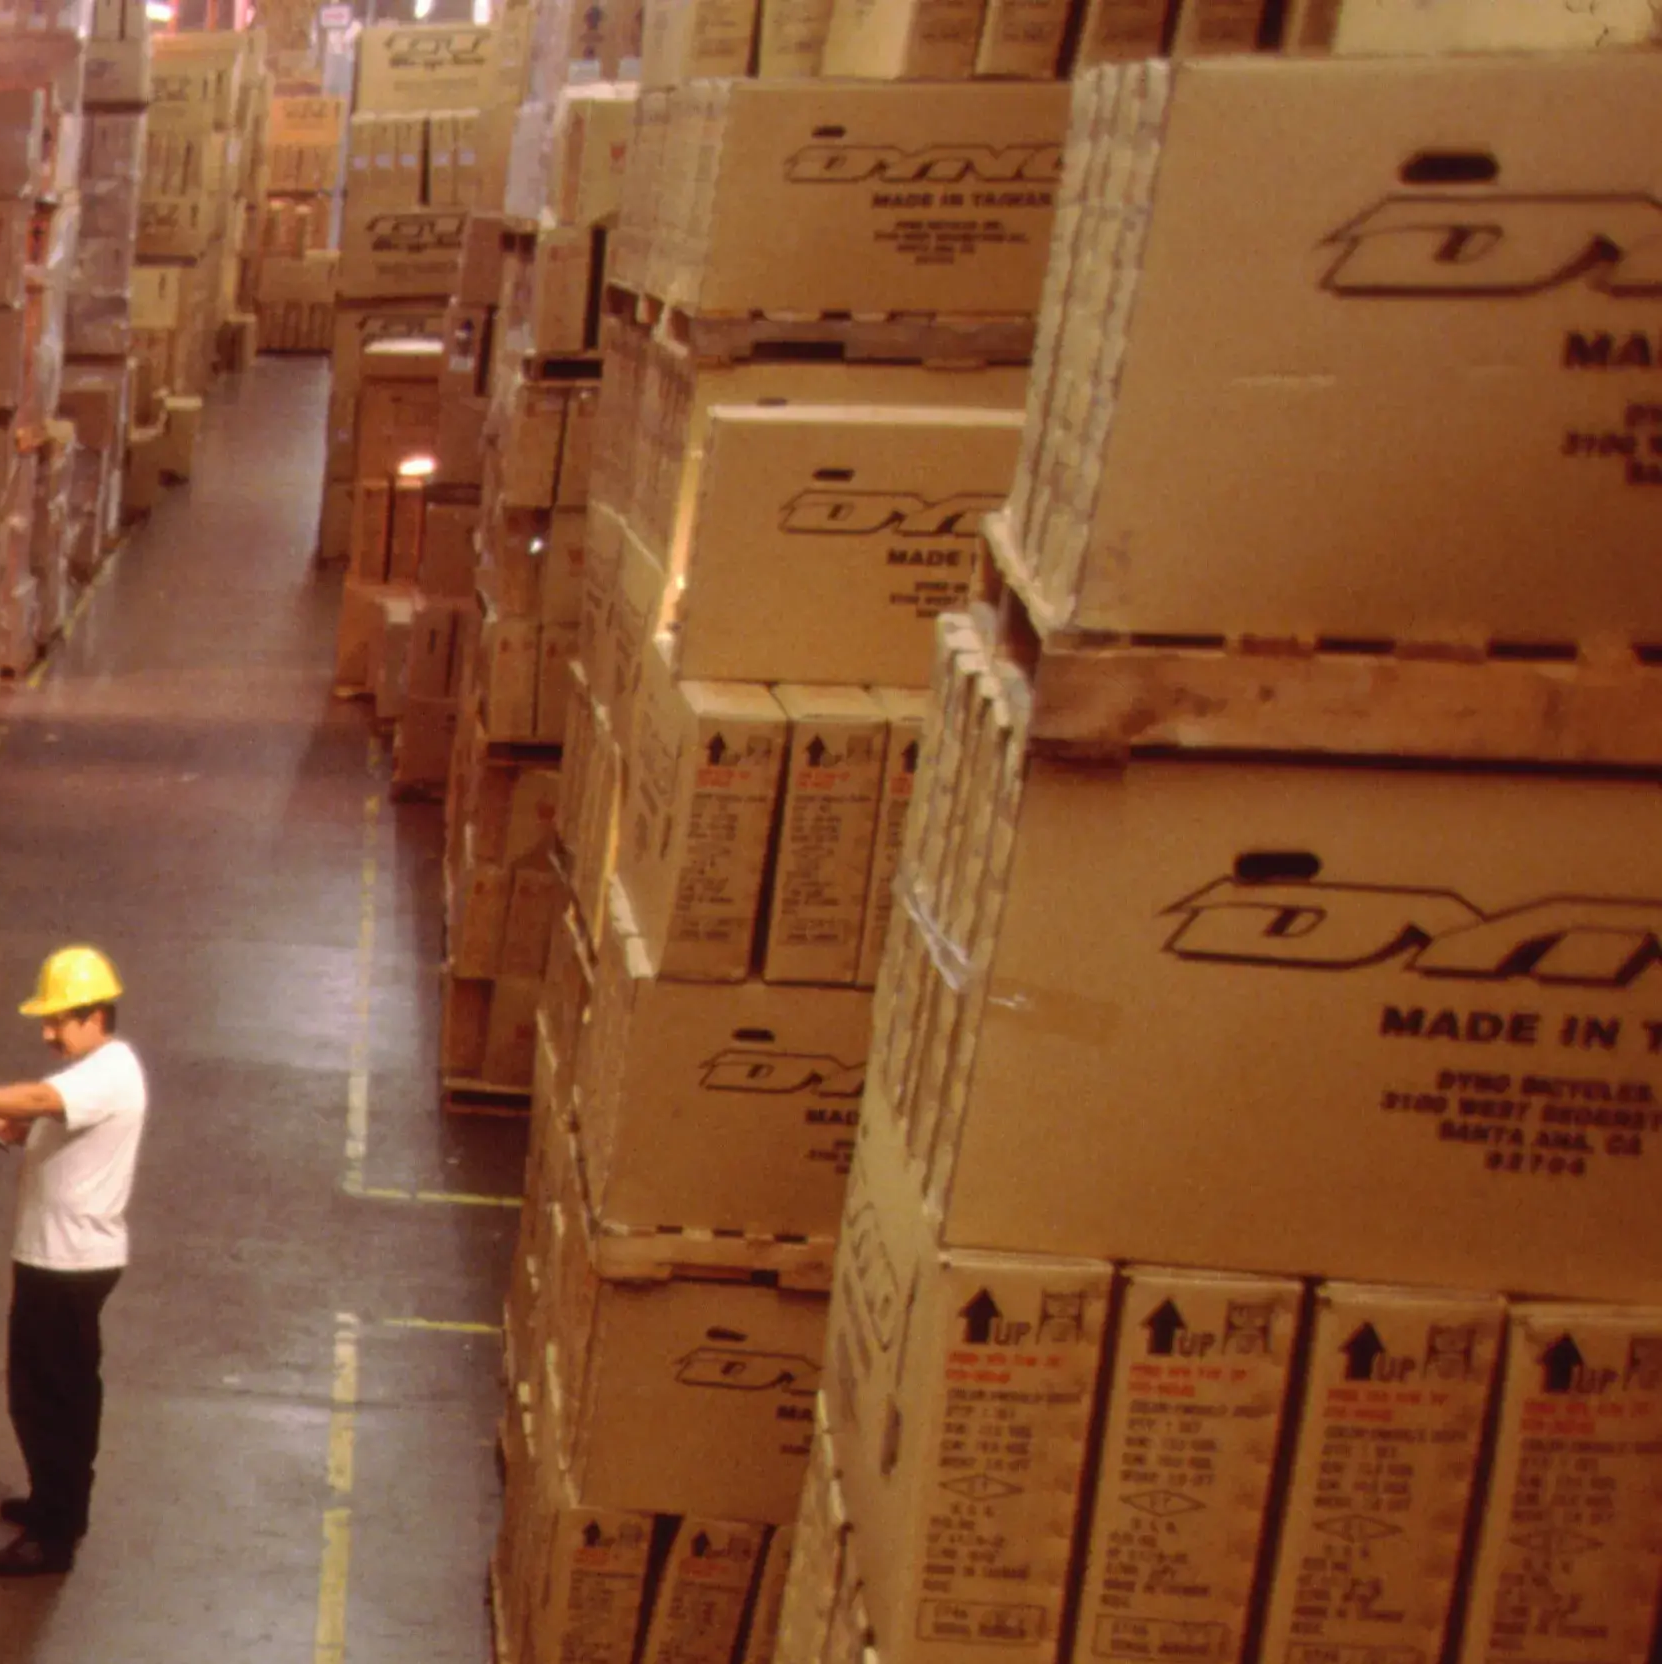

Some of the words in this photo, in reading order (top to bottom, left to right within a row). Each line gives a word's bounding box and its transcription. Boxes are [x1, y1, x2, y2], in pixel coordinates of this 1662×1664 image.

[871, 192, 932, 210] MADE
[939, 192, 964, 208] IN
[971, 192, 1053, 208] TAIWAN
[887, 548, 960, 566] MADE
[1380, 1004, 1541, 1046] MADE
[1561, 1016, 1621, 1051] IN
[1436, 1069, 1511, 1094] DYNO
[1438, 1121, 1525, 1147] SANTA
[994, 1322, 1029, 1346] UP
[1179, 1333, 1214, 1358] UP
[1378, 1357, 1416, 1382] UP
